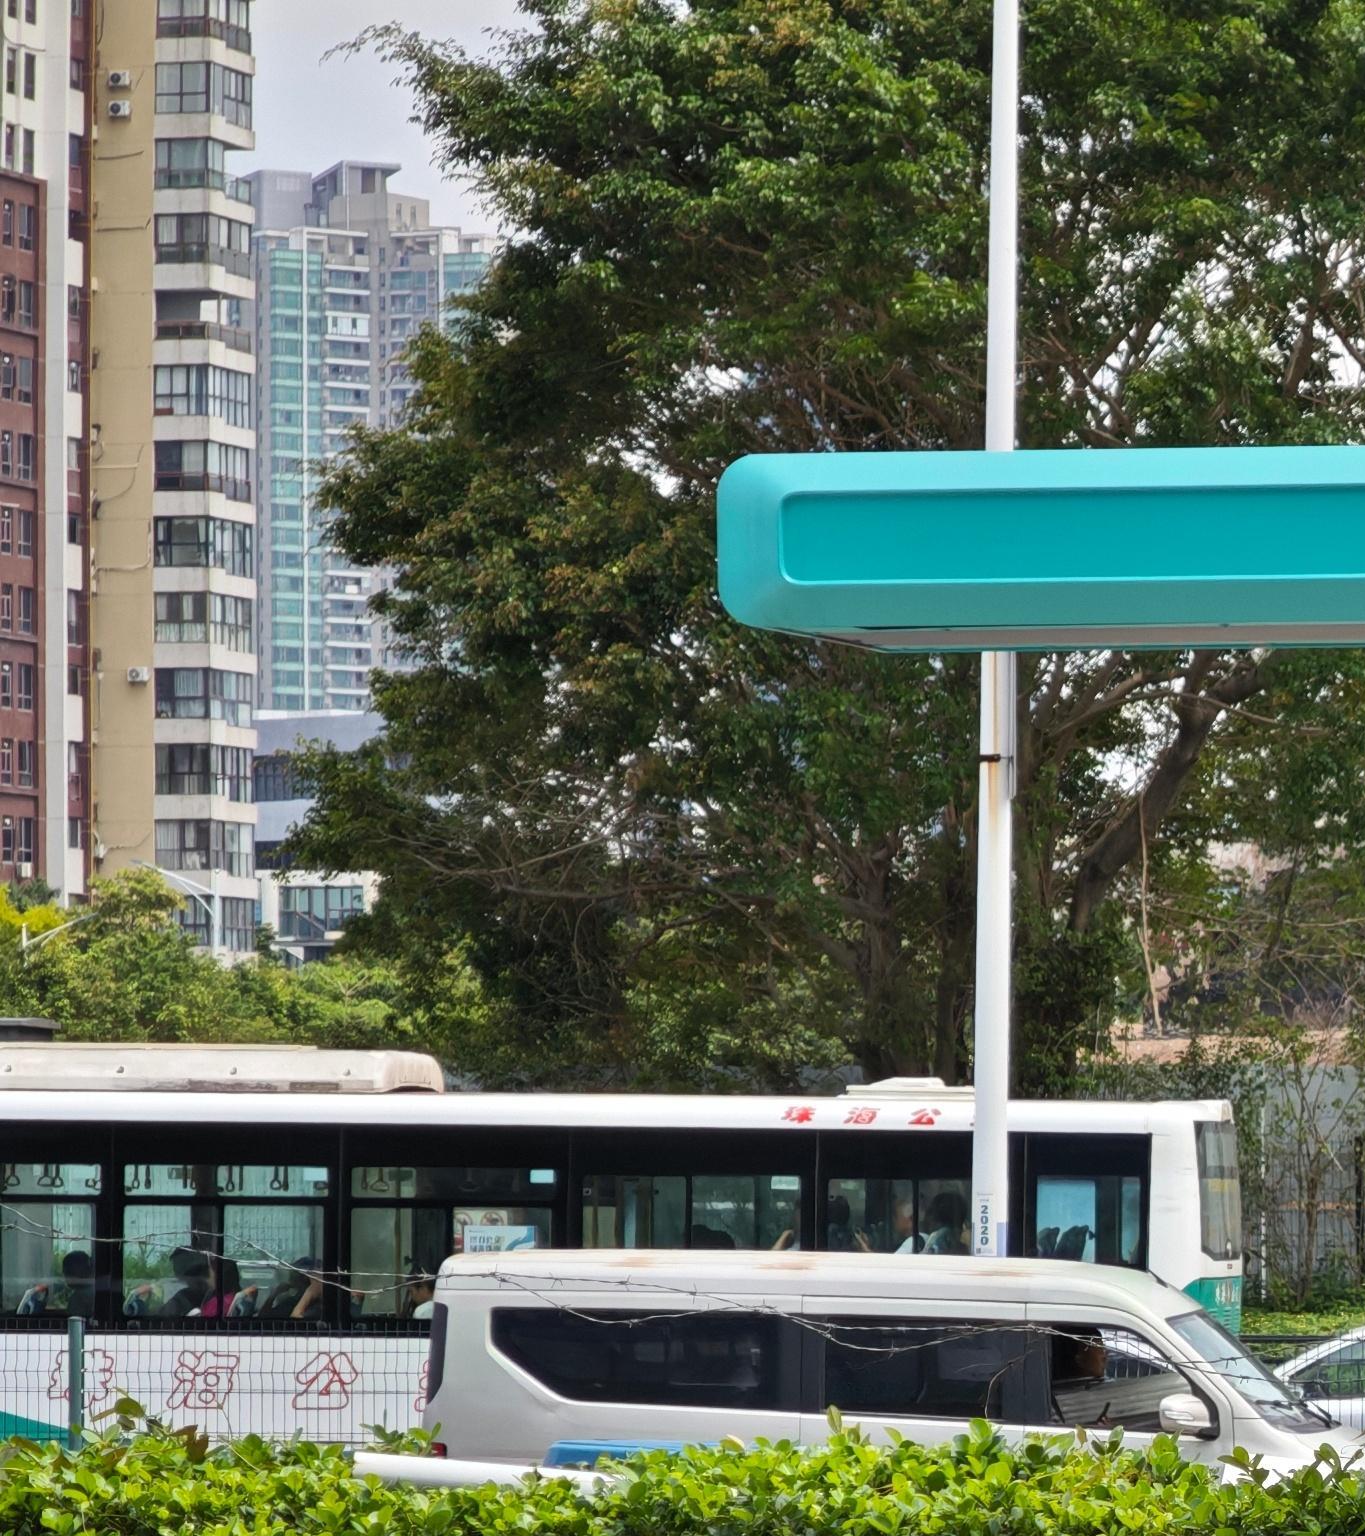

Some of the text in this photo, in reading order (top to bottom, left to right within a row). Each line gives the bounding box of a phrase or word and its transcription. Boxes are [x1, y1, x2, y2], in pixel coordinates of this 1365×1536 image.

[781, 1106, 975, 1126] 珠海公
[980, 1205, 989, 1246] 2020
